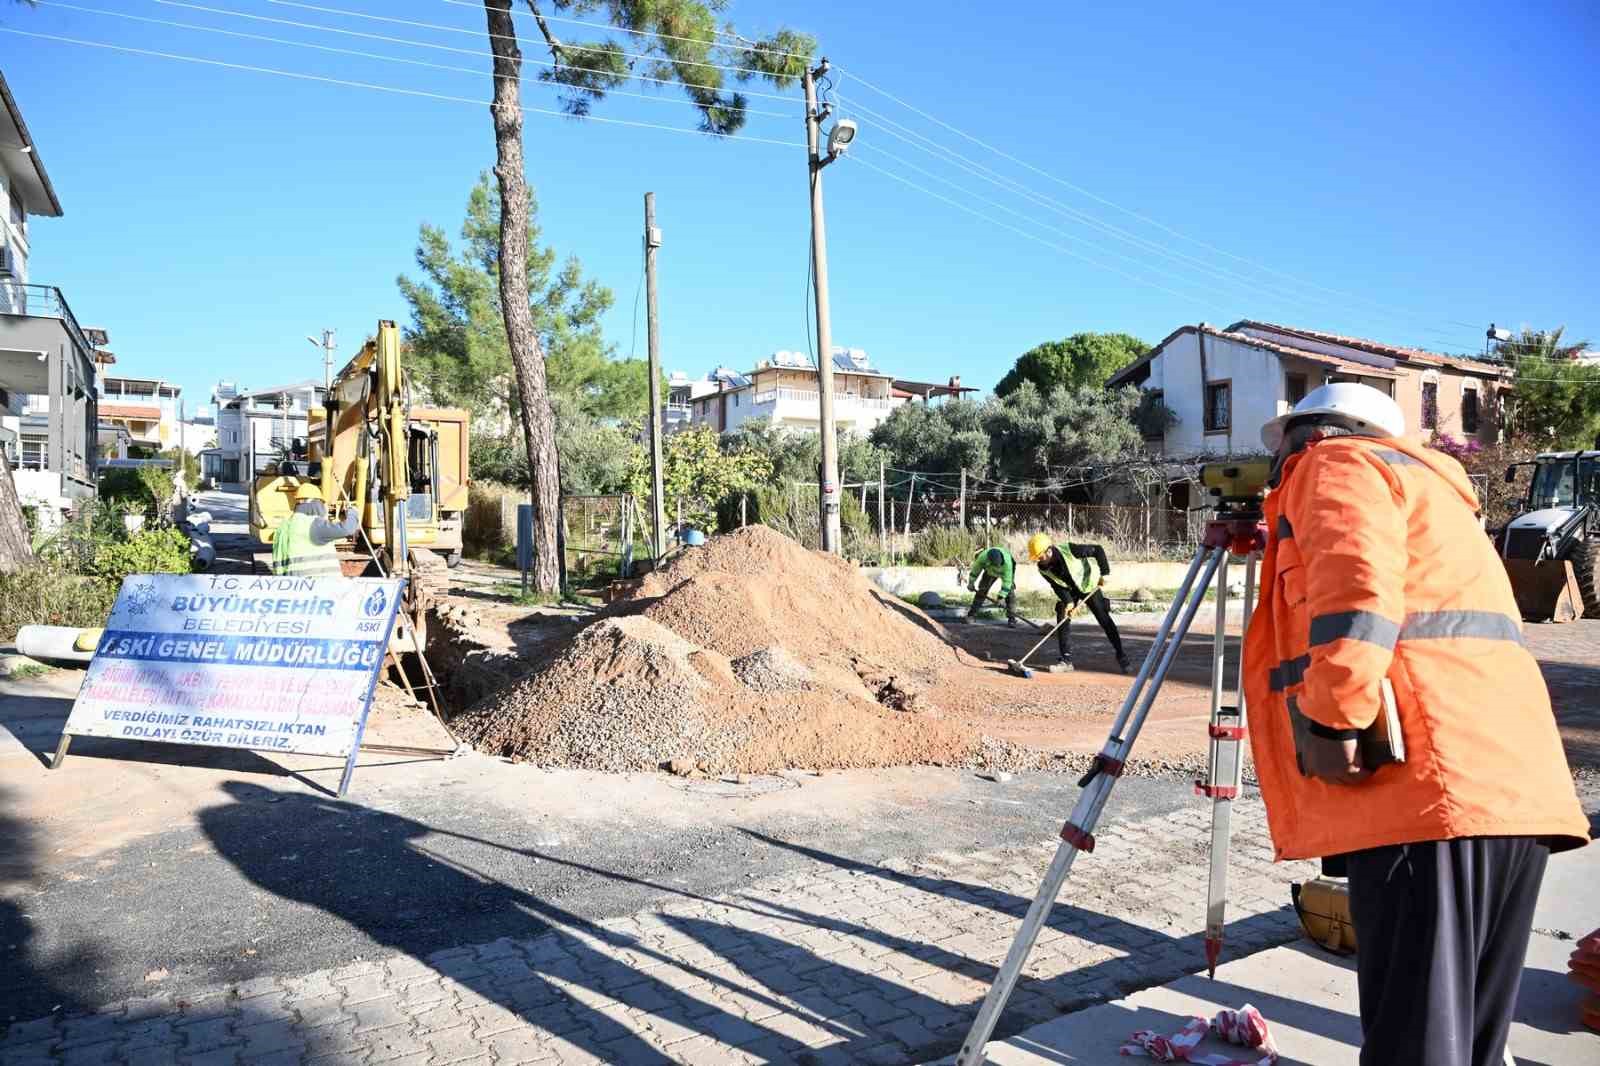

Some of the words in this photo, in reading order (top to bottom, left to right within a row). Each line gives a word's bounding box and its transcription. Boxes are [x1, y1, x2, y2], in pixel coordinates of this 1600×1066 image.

[208, 577, 243, 590] T.C.
[249, 576, 316, 591] AYDIN
[171, 593, 335, 617] BÜYÜKŞEHİR
[183, 617, 312, 634] BELEDİYESİ
[157, 639, 229, 660] GENEL
[234, 640, 380, 665] MÜDÜRLÜĞÜ
[103, 710, 189, 726] VERDİĞİMİZ
[192, 716, 326, 736] RAHATSIZLIKTAN
[122, 725, 177, 740] DOLAYI
